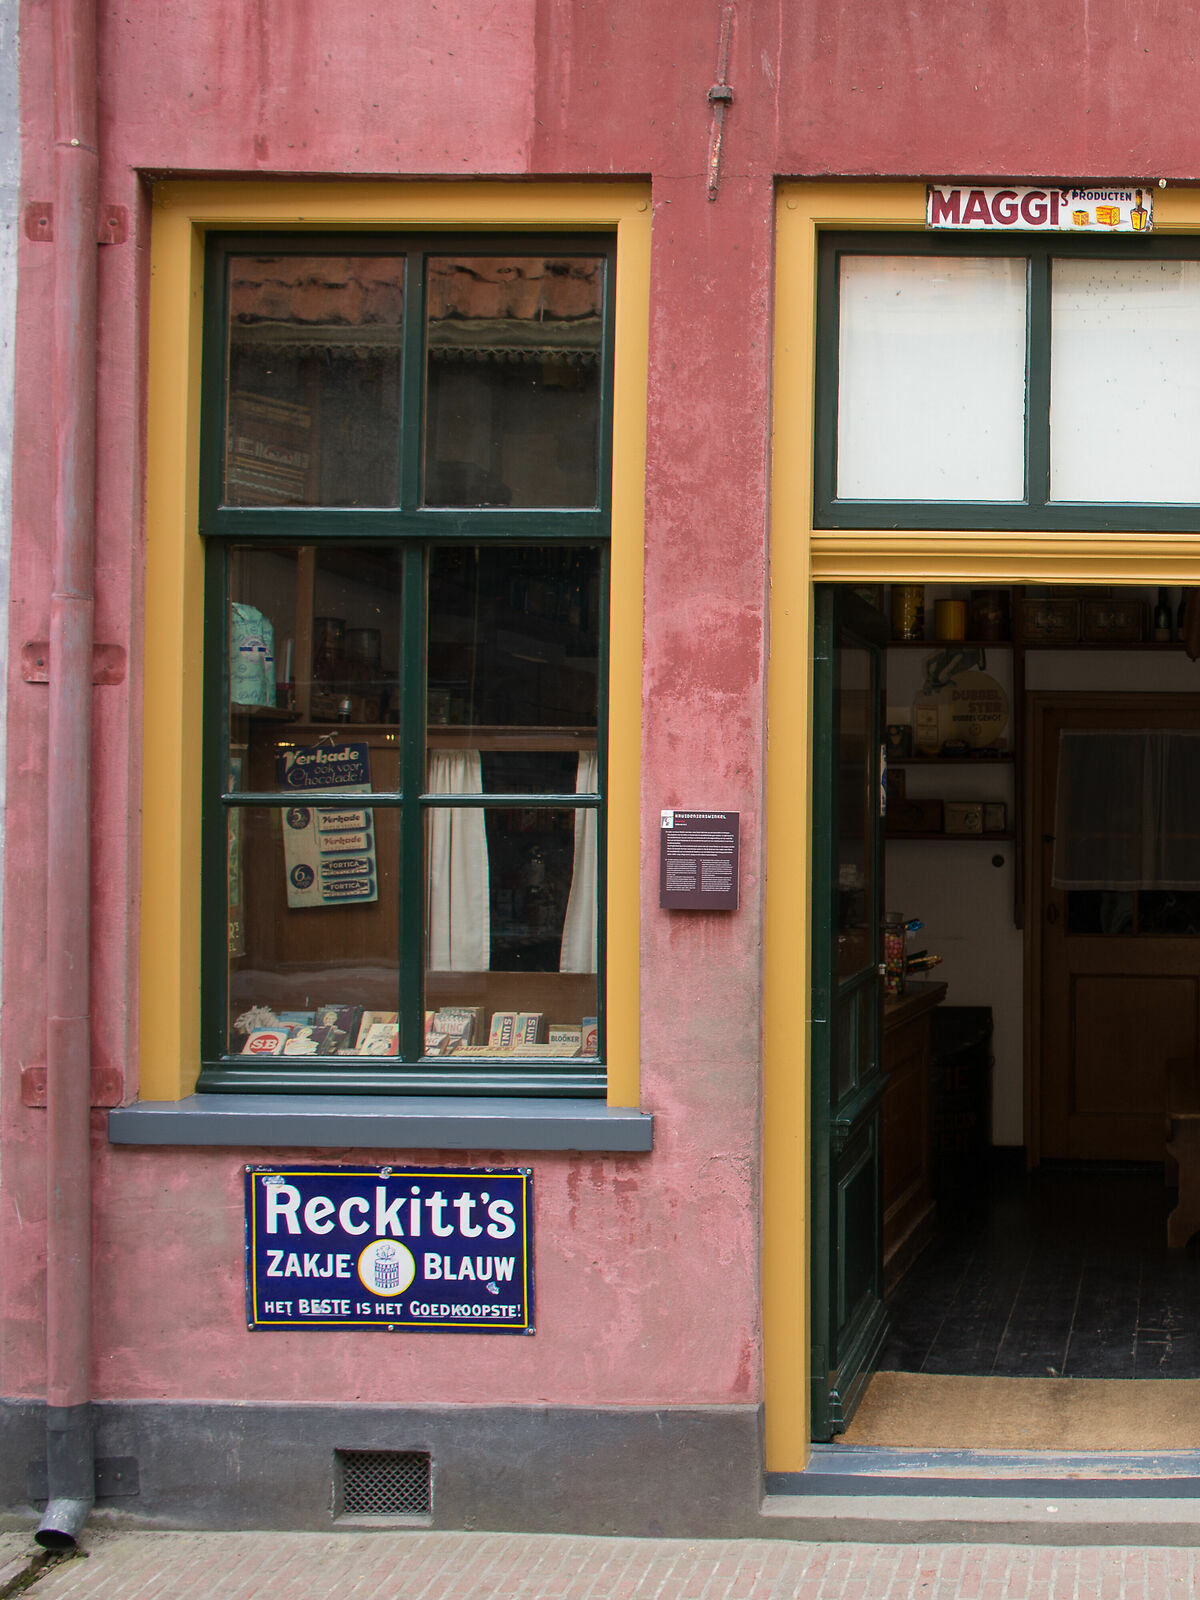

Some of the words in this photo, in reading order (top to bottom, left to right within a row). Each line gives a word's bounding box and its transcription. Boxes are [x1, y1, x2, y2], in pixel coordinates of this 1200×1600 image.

[1072, 191, 1132, 202] PRODUCTEN
[282, 747, 360, 774] Verkade
[314, 763, 334, 775] ook
[336, 762, 363, 773] voor
[250, 1039, 278, 1050] SB
[266, 1183, 516, 1240] Reckitt's
[266, 1250, 351, 1279] ZAKJE
[424, 1252, 516, 1281] BLAUW
[264, 1301, 292, 1316] HET
[299, 1299, 351, 1316] BESTE
[356, 1303, 371, 1315] IS
[375, 1303, 403, 1316] HET
[410, 1301, 521, 1318] GOEDKOOPSTE!
